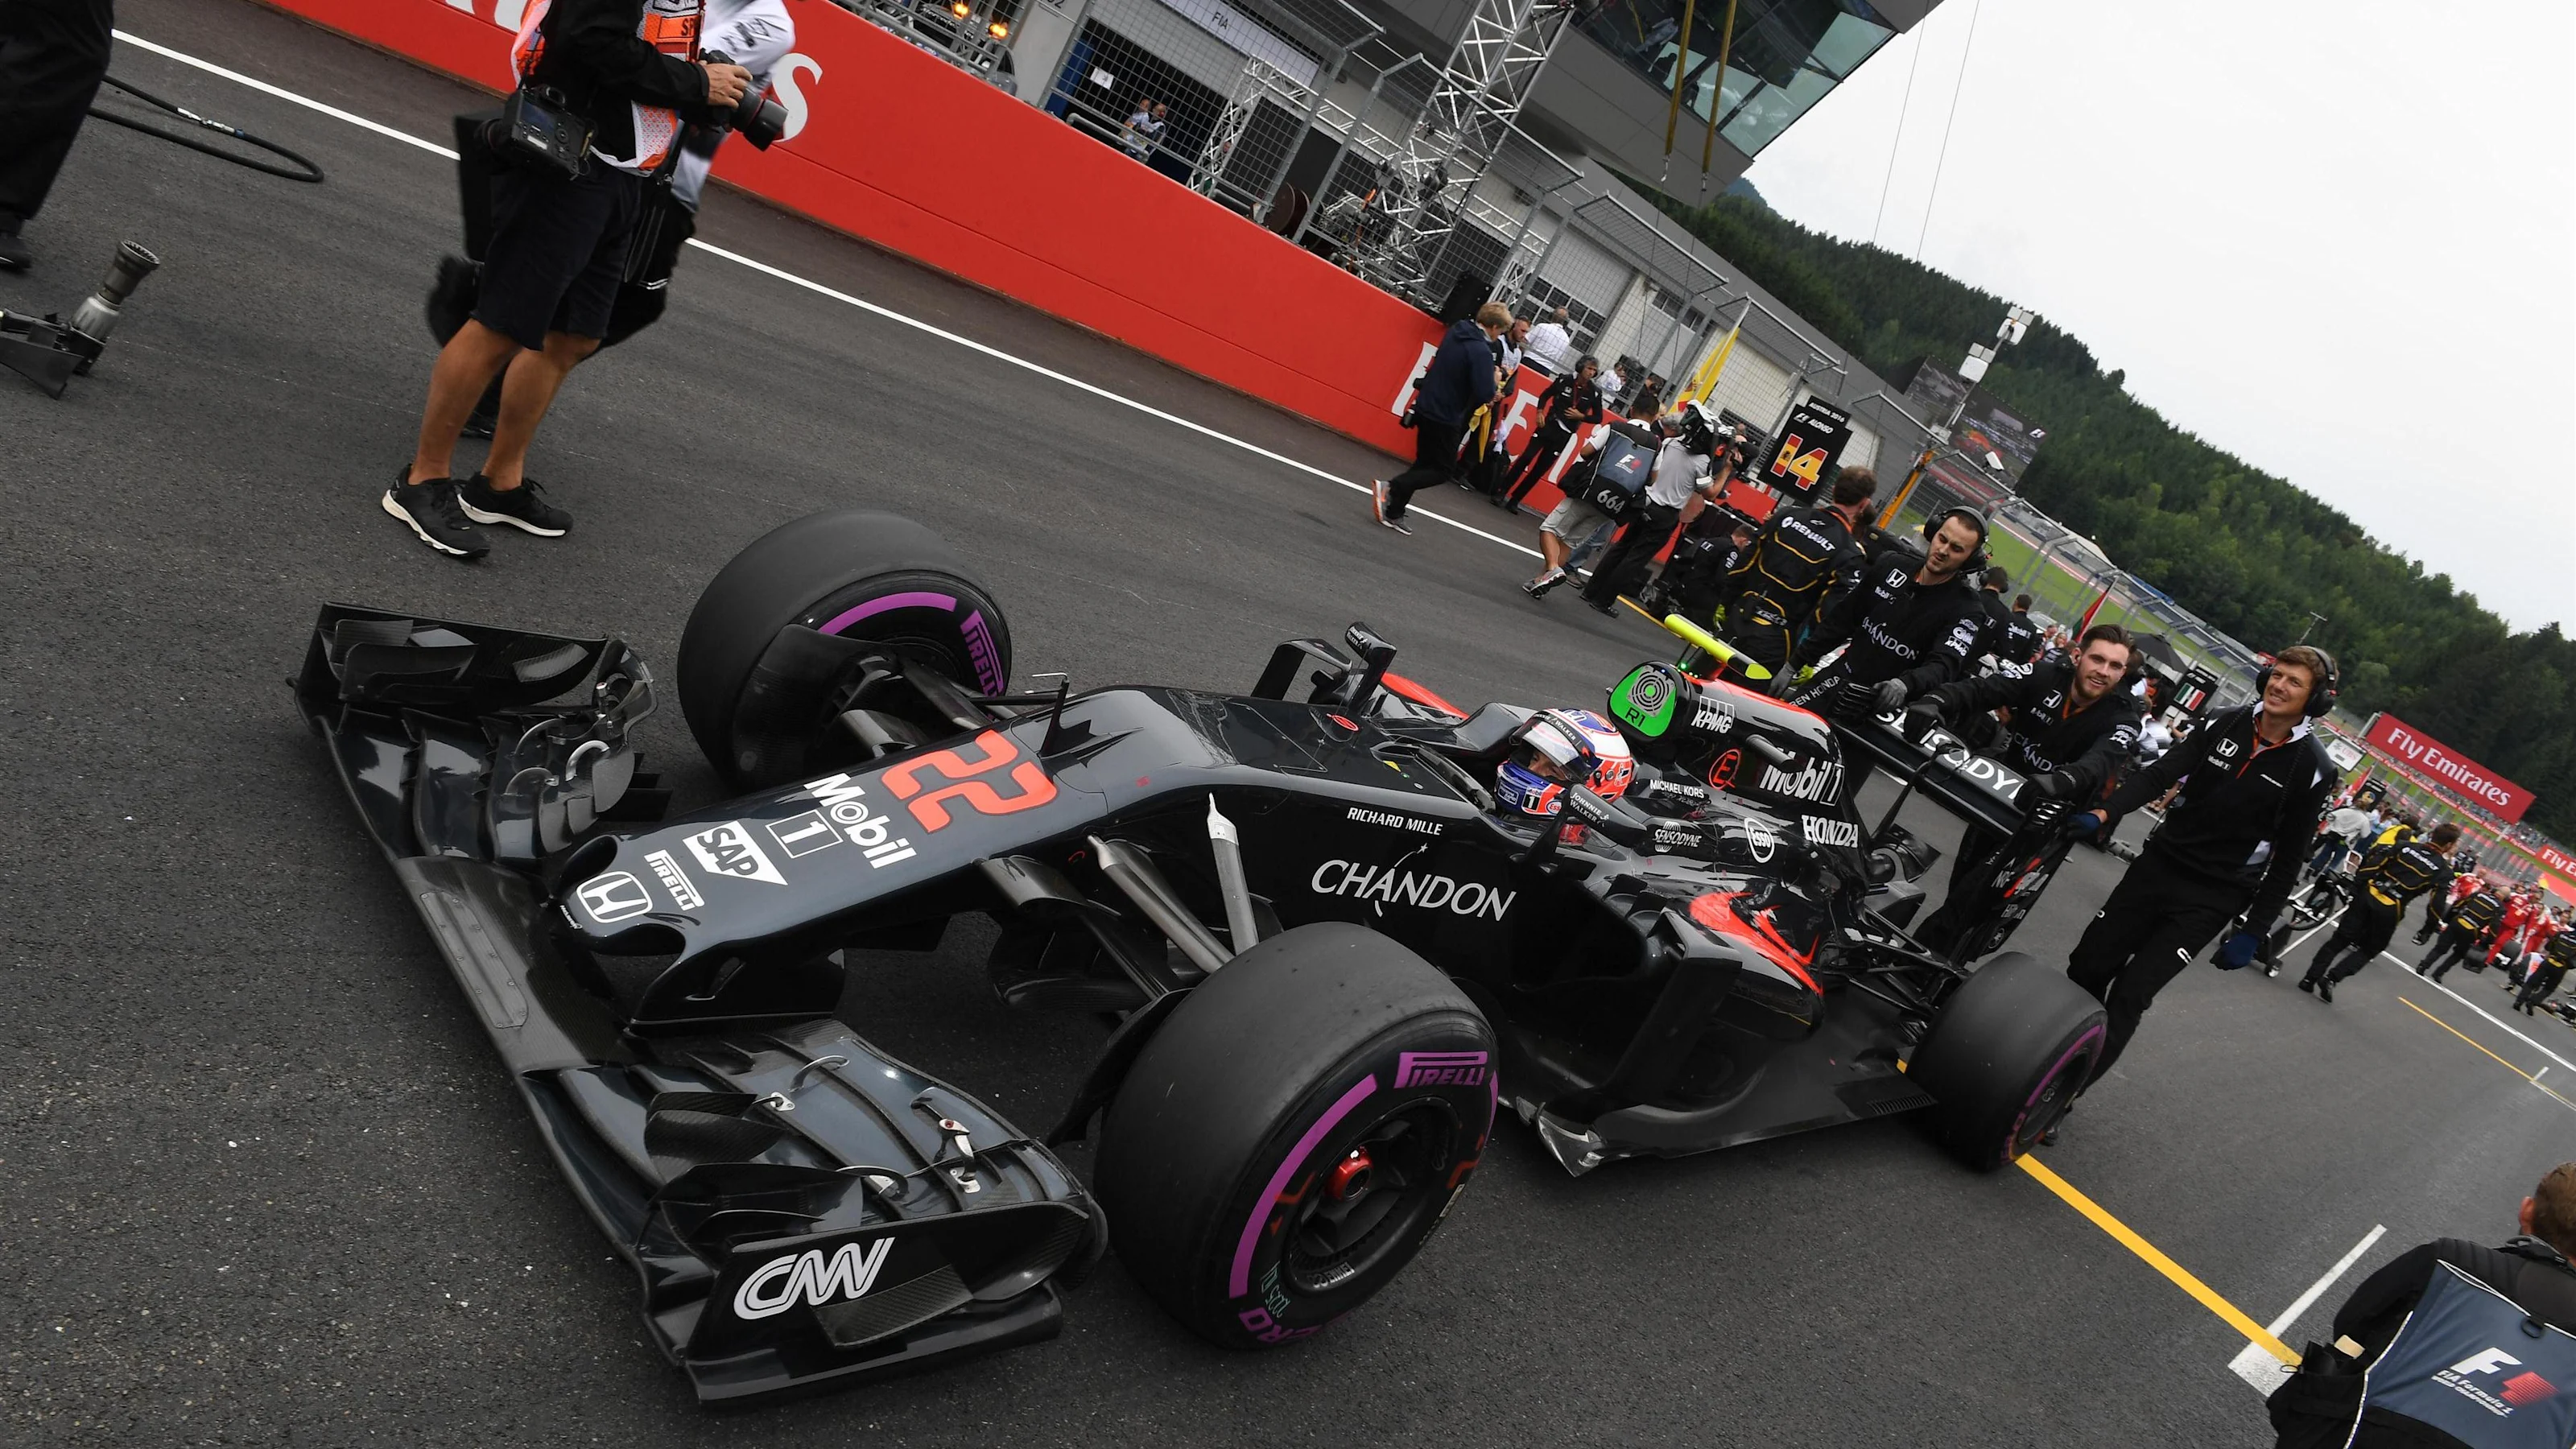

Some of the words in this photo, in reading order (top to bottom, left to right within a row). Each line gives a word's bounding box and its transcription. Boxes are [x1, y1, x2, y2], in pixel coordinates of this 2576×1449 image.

[1212, 11, 1228, 30] FIA
[1809, 402, 1831, 415] AUSTRIA
[1830, 412, 1845, 423] 2016
[1807, 419, 1834, 434] ALONSO
[1770, 433, 1829, 491] 14
[1597, 489, 1626, 514] 664
[1791, 522, 1835, 551] RENAULT
[1944, 636, 1969, 656] KPMG
[1809, 676, 1840, 698] HONDA
[1555, 720, 1576, 741] WALKER
[1625, 707, 1645, 727] R1
[1691, 702, 1733, 733] KPMG
[2387, 727, 2424, 760] Fly
[2422, 746, 2512, 806] Emirates
[881, 729, 1057, 832] 22
[1650, 779, 1682, 795] MICHAEL
[1683, 785, 1704, 799] KORS
[1528, 796, 1535, 809] 1
[1571, 793, 1602, 815] JOHNNIE
[1571, 799, 1597, 822] WALKER
[803, 773, 917, 869] Mobil
[1347, 807, 1404, 828] RICHARD
[1405, 818, 1443, 836] MILLE
[1802, 814, 1859, 848] HONDA
[696, 827, 759, 876] SAP
[1652, 828, 1702, 848] SENSODYNE
[2541, 848, 2567, 869] Fly
[644, 849, 705, 911] PIRELLI
[1311, 860, 1517, 921] CHANDON
[1393, 1051, 1488, 1088] PIRELLI
[733, 1237, 896, 1319] CNN
[2437, 1369, 2461, 1382] FIA
[2457, 1379, 2505, 1408] Formula
